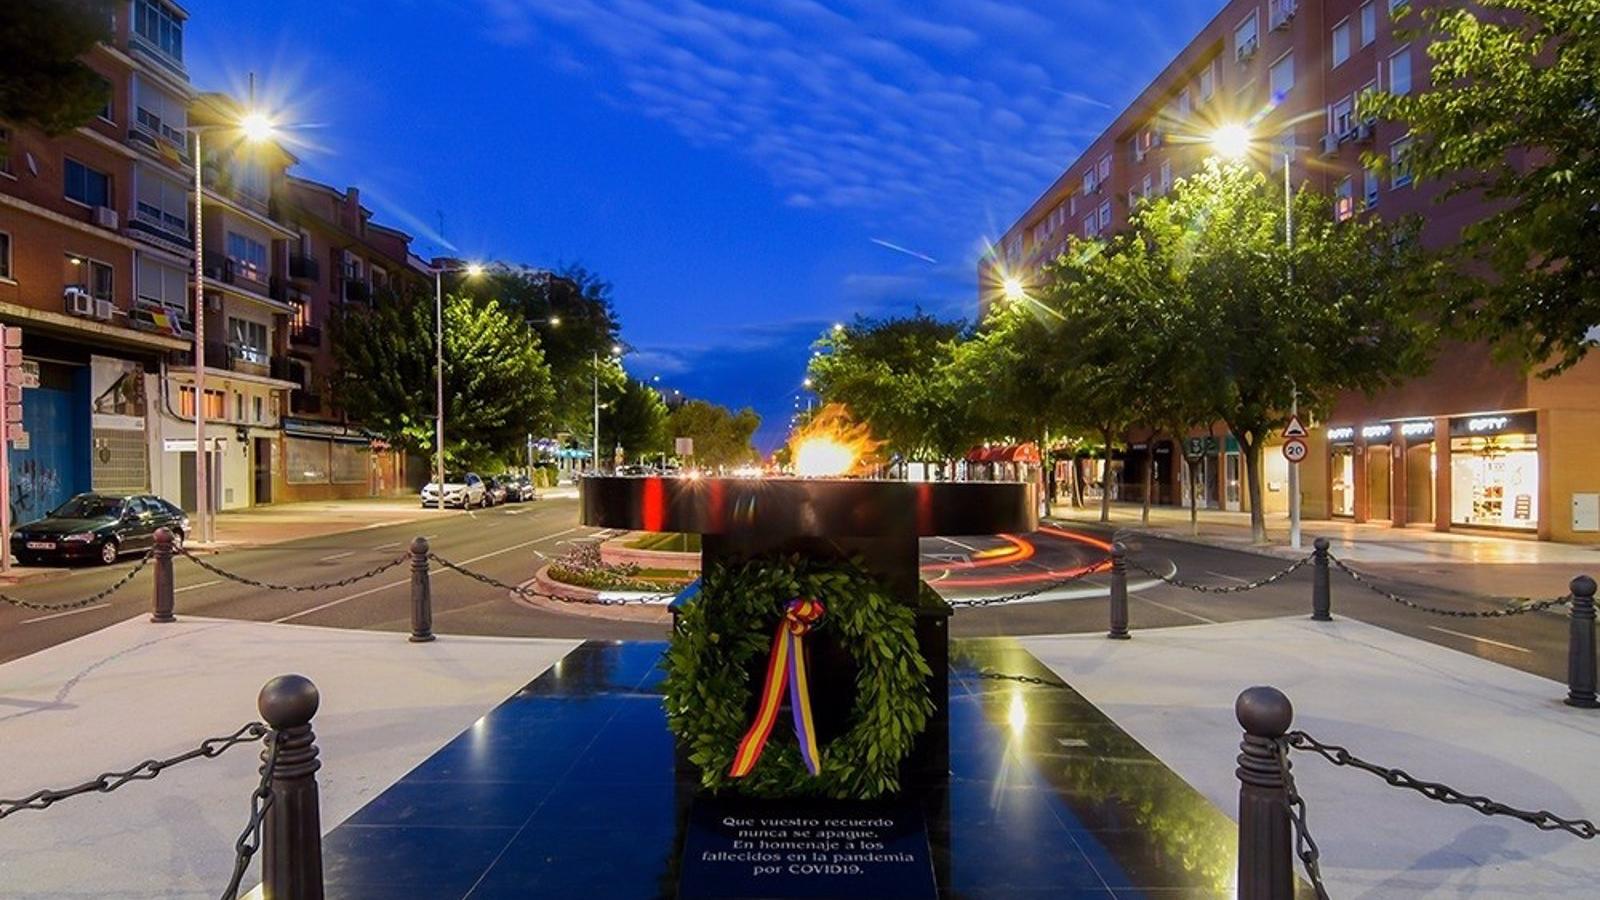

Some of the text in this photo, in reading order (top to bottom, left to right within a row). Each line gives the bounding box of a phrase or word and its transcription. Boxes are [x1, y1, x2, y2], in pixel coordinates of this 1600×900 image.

[1287, 446, 1303, 456] 20
[722, 817, 894, 827] Que vuestro recuerdo
[738, 830, 788, 839] nunca
[816, 830, 879, 840] apague.
[733, 839, 884, 852] En homenaje a los
[702, 851, 915, 864] fallecidos en la pandemia
[753, 864, 865, 876] por COVID19.
